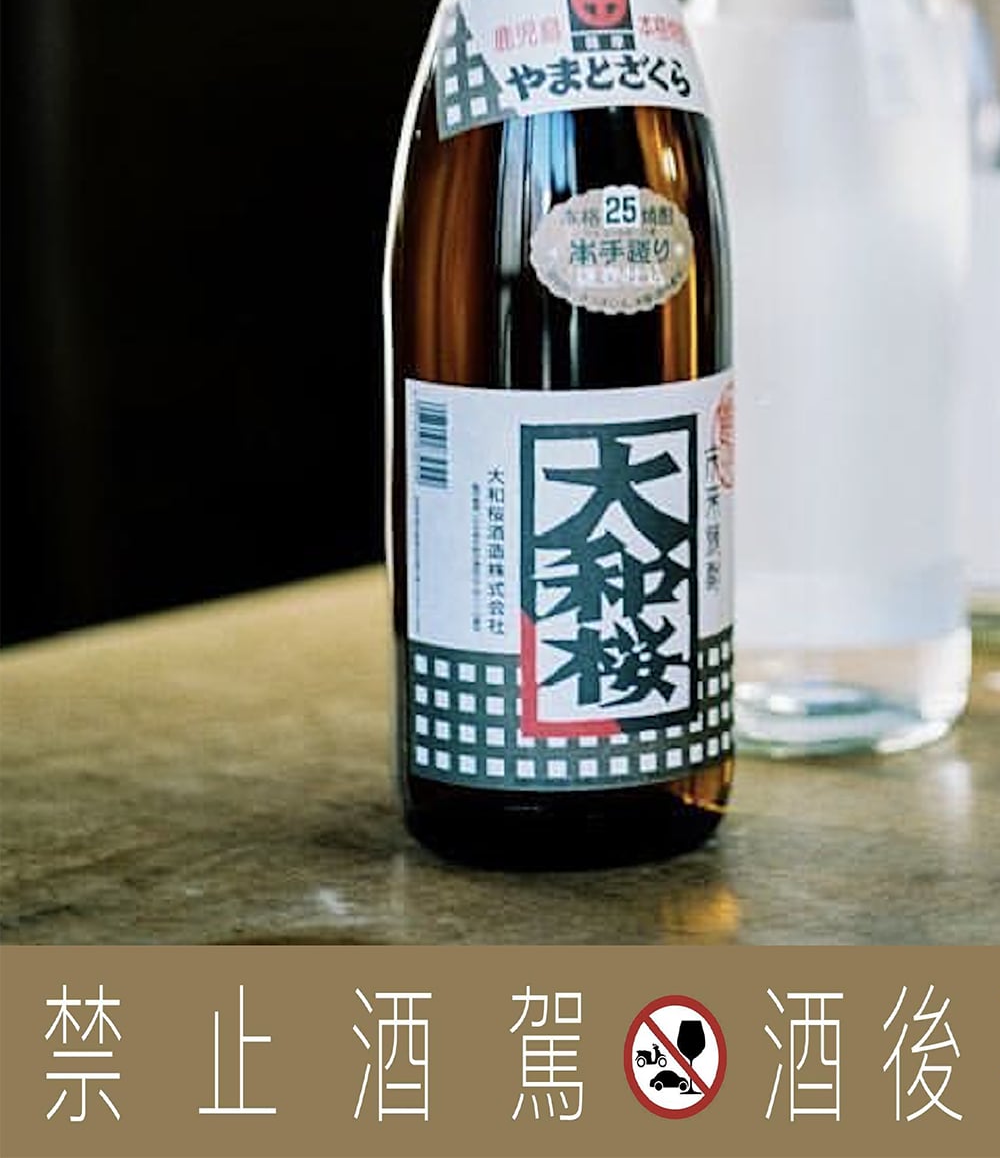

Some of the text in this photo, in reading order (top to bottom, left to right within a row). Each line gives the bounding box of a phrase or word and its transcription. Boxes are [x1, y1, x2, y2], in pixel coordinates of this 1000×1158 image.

[506, 54, 692, 101] やまとざくら
[605, 195, 637, 225] 25
[486, 464, 506, 636] 大和桜酒造株式会社
[536, 434, 687, 709] 大和桜
